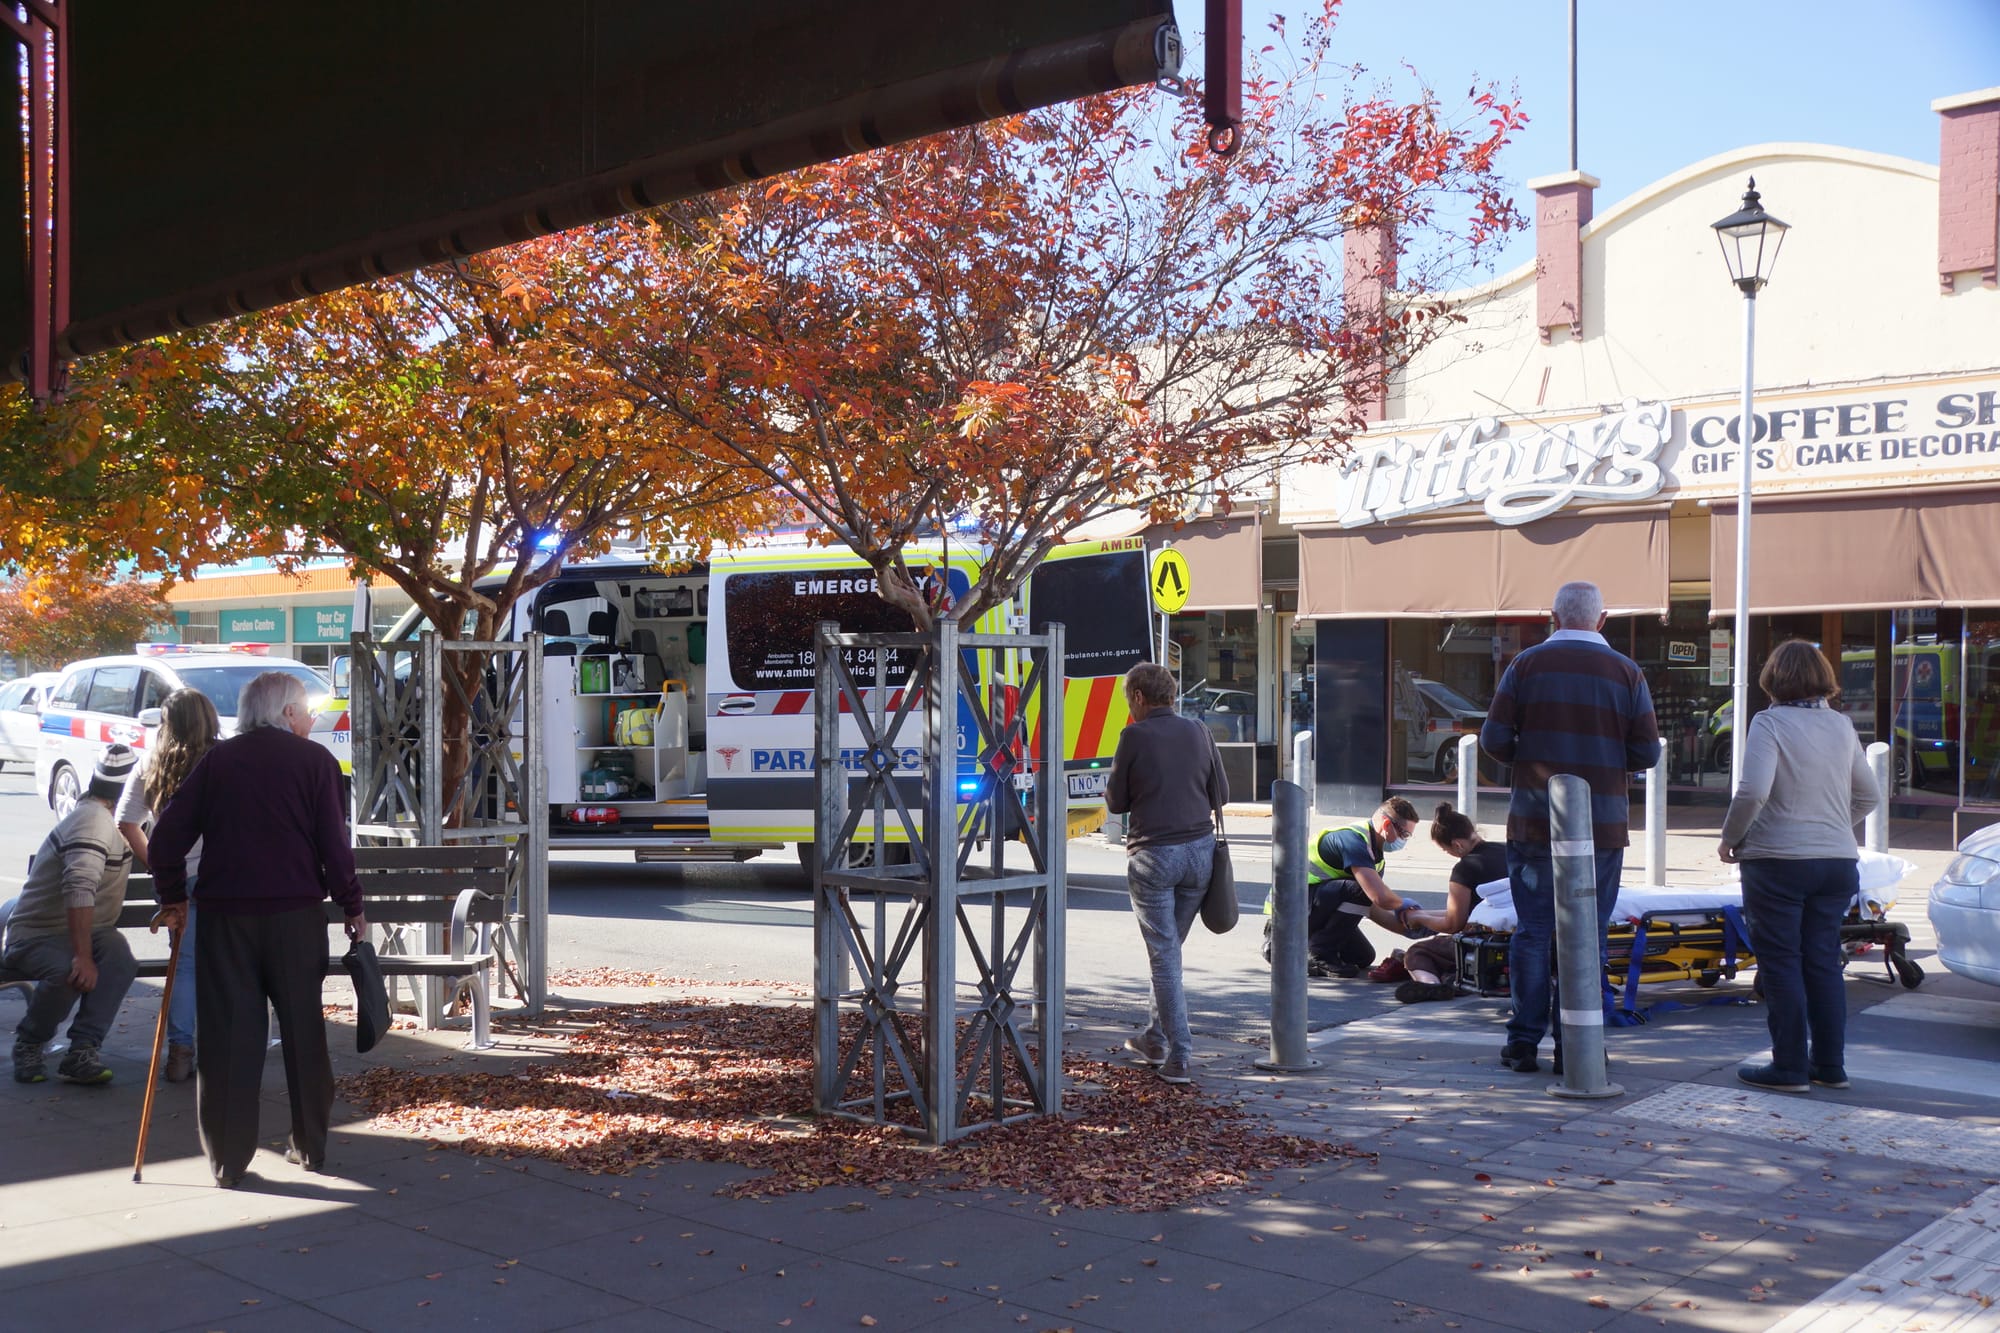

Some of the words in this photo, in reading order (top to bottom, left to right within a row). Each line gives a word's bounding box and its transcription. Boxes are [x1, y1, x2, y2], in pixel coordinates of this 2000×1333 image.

[1690, 399, 1908, 449] COFFEE
[1337, 397, 1672, 527] Tiffany's
[1691, 447, 1774, 475] GIFS
[1796, 440, 1873, 468] CAKE
[794, 576, 929, 596] EMERGEY
[232, 619, 253, 632] Garden
[254, 619, 275, 631] Centre
[317, 611, 332, 624] Rear
[333, 610, 346, 623] Car
[317, 624, 344, 640] Parking
[1064, 649, 1140, 660] mbulance.vic.gov.au
[1672, 644, 1695, 656] OPEN
[753, 749, 920, 771] PAREDC
